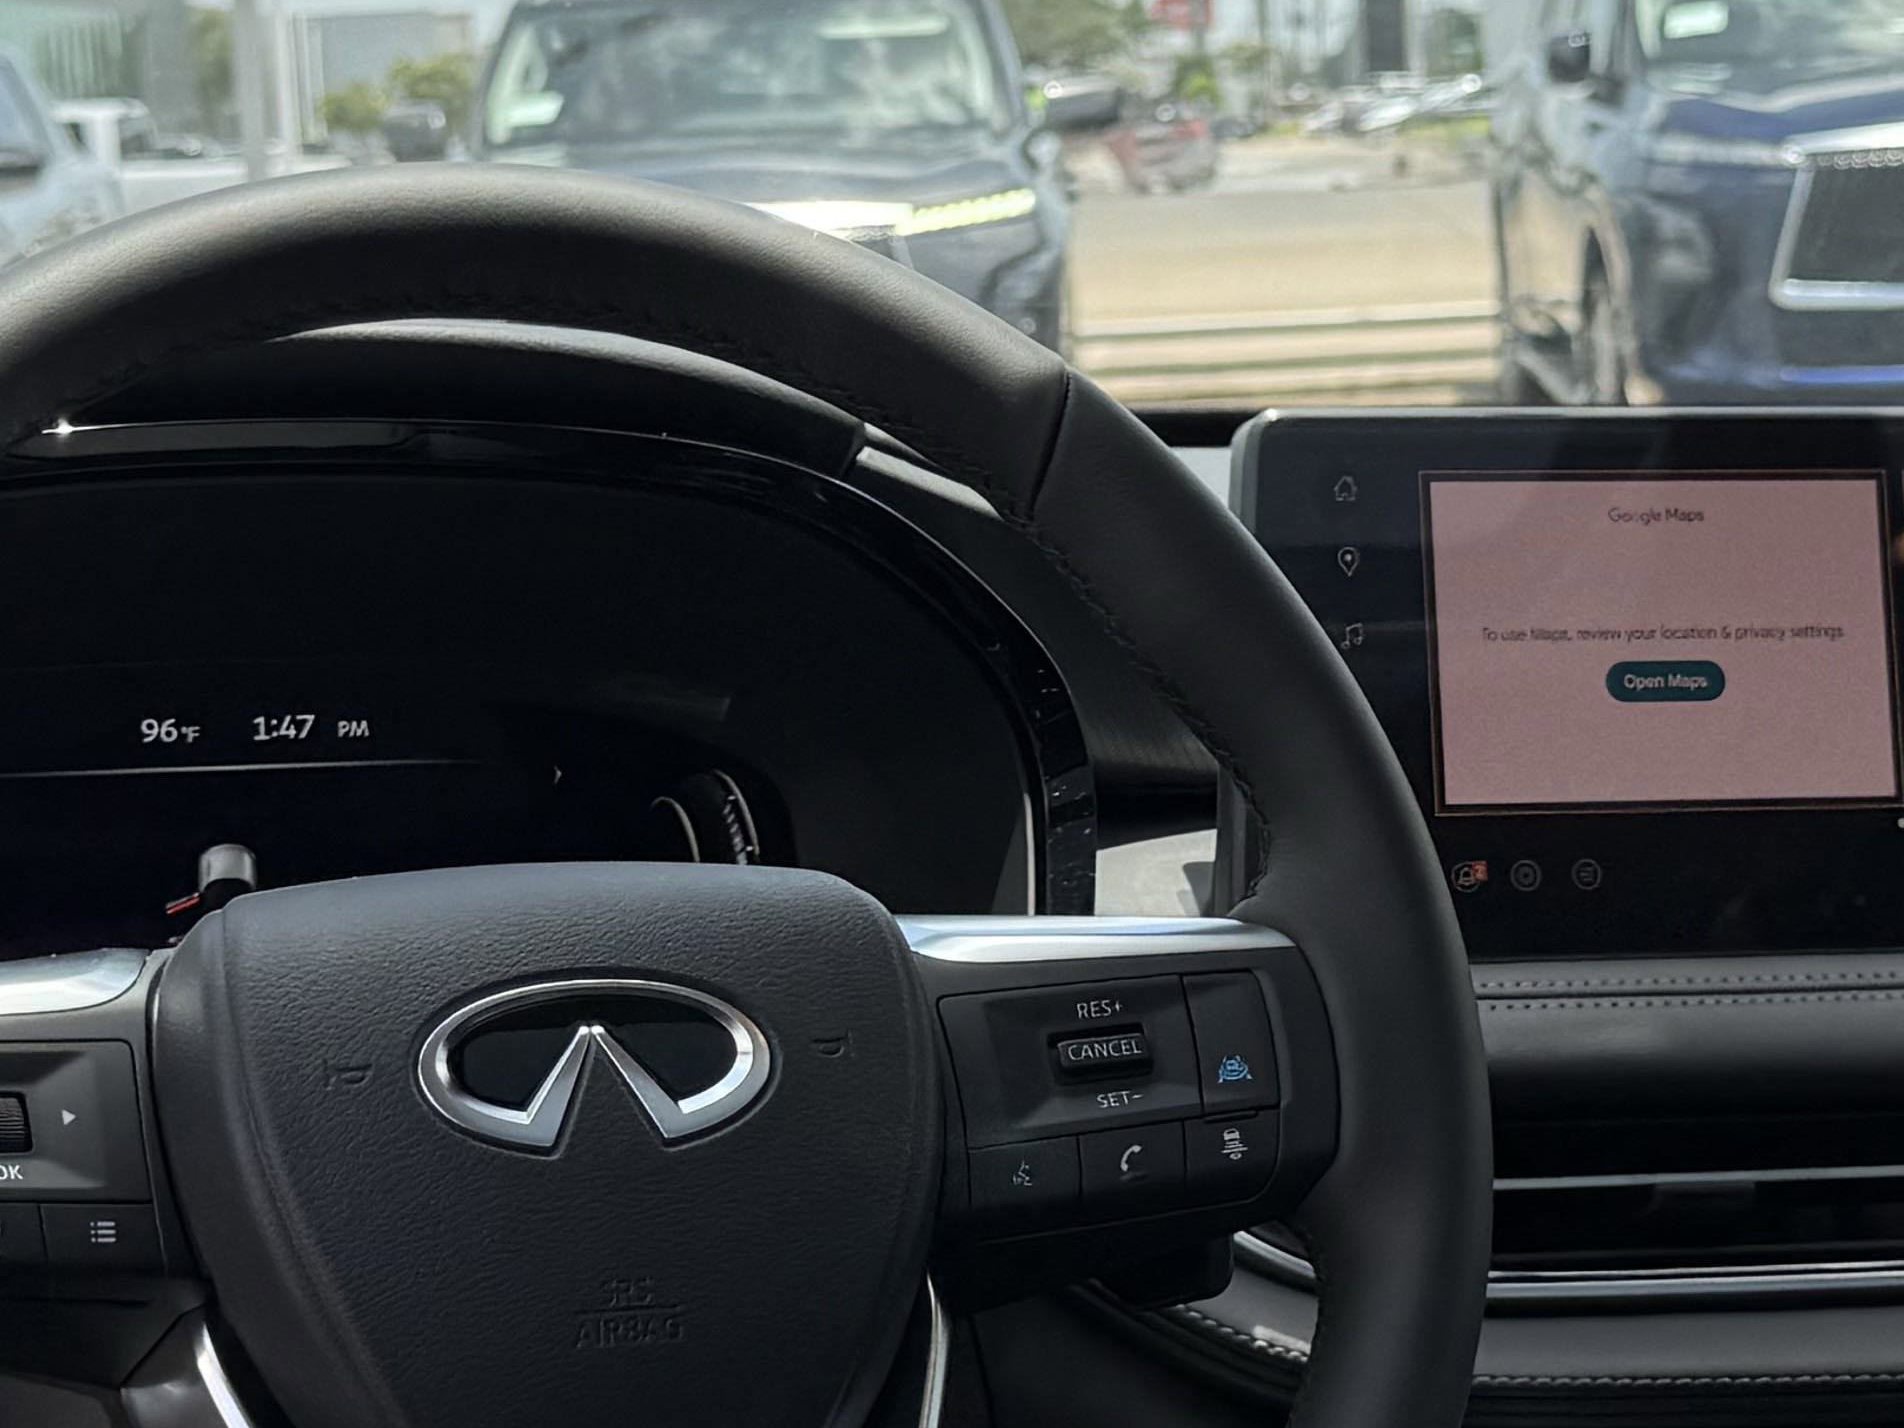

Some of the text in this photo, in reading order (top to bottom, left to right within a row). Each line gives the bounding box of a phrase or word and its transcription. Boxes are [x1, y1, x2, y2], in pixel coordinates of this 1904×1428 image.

[1607, 507, 1705, 525] Google Maps
[1576, 626, 1622, 641] review
[1624, 627, 1656, 644] your
[1660, 623, 1718, 640] location
[1734, 625, 1786, 642] privacy
[1623, 673, 1709, 691] Open Maps
[252, 714, 316, 741] 1:47
[337, 719, 370, 738] PM
[1075, 999, 1123, 1019] RES+
[1066, 1037, 1144, 1062] CANCEL
